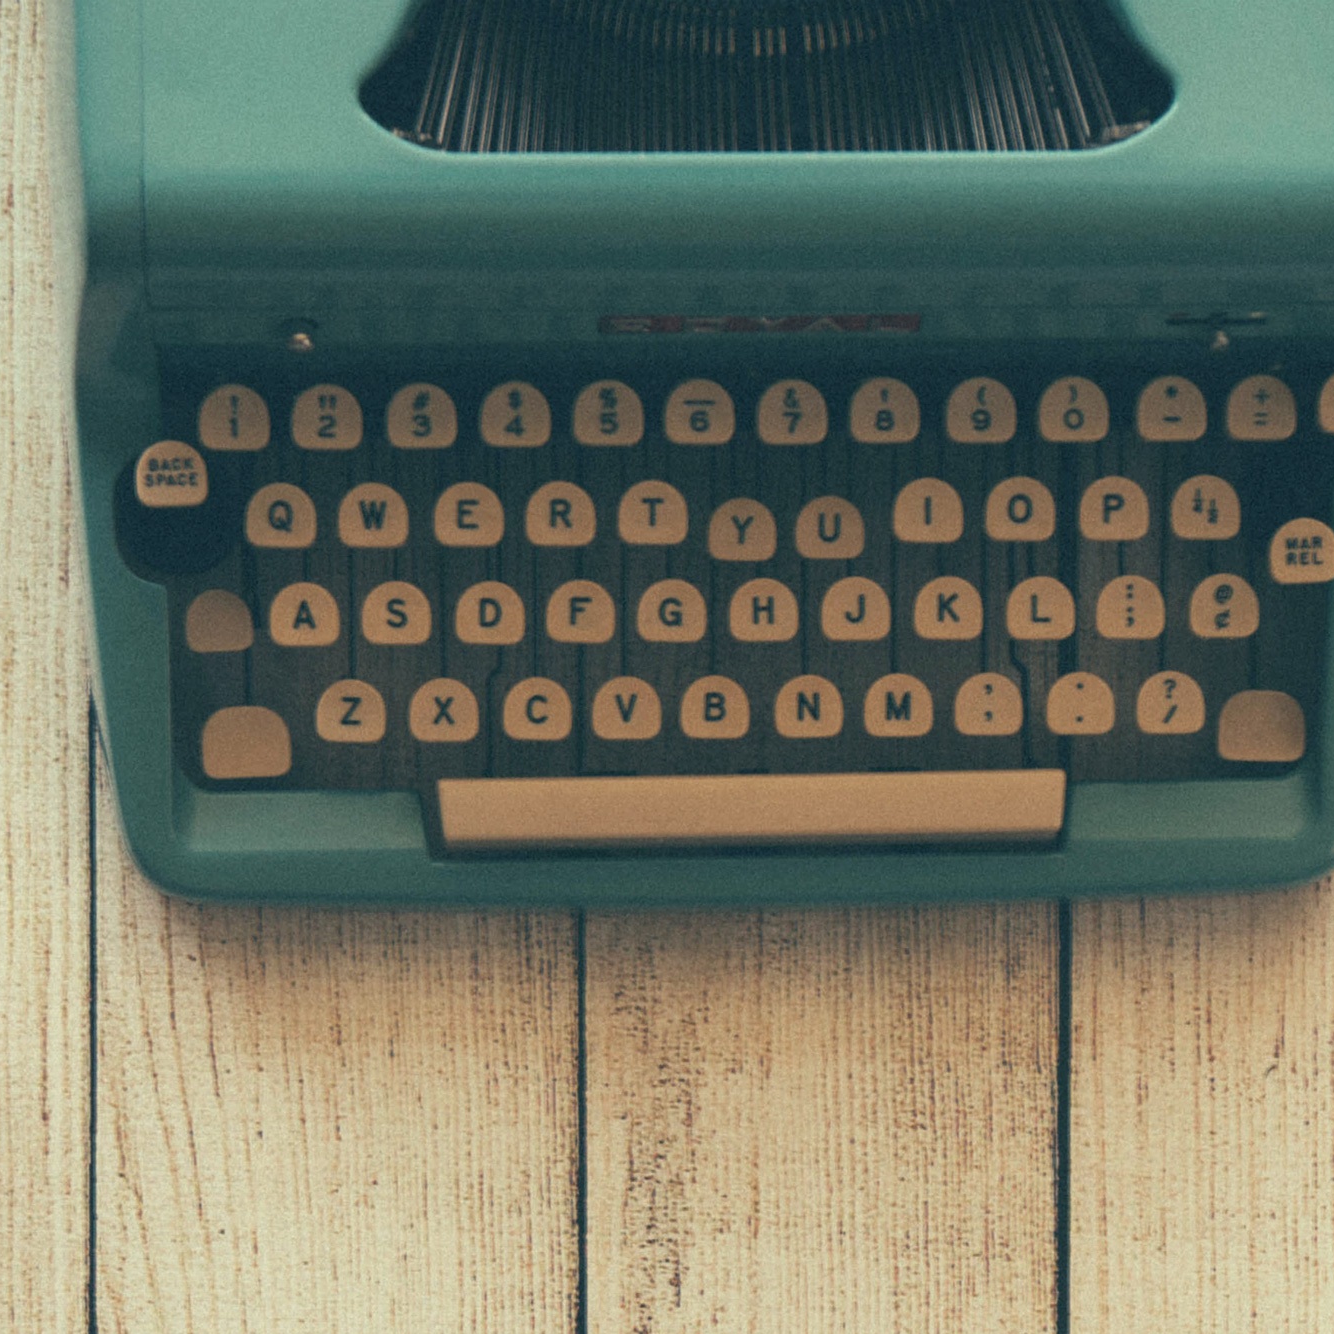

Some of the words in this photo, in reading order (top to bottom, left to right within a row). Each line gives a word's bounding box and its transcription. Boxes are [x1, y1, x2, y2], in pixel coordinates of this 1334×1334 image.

[228, 417, 240, 439] 1
[317, 414, 338, 438] 2
[411, 414, 432, 438] 3
[503, 414, 525, 437] 4
[598, 411, 620, 435] 5
[689, 410, 711, 433] 6
[782, 411, 803, 434] 7
[874, 408, 896, 432] 8
[970, 409, 993, 432] 9
[147, 456, 195, 472] BACK
[144, 472, 199, 488] SPACE
[266, 499, 294, 533] Q
[357, 499, 388, 531] W
[456, 498, 480, 530] E
[548, 497, 573, 529] R
[640, 496, 666, 527] T
[922, 495, 933, 526] I
[1006, 492, 1034, 525] O
[1102, 492, 1126, 524] P
[731, 514, 755, 545] Y
[817, 511, 843, 544] U
[1285, 535, 1323, 550] MAR
[1285, 551, 1324, 566] REL
[292, 599, 317, 630] A
[386, 597, 409, 629] S
[478, 597, 503, 629] D
[568, 595, 593, 626] F
[658, 596, 683, 627] G
[751, 595, 775, 625] H
[844, 593, 867, 624] J
[936, 592, 960, 623] K
[1030, 593, 1053, 624] L
[339, 695, 363, 727] Z
[432, 696, 455, 726] X
[525, 694, 549, 725] C
[614, 693, 638, 723] V
[703, 691, 727, 723] B
[796, 691, 821, 722] N
[885, 691, 912, 721] M
